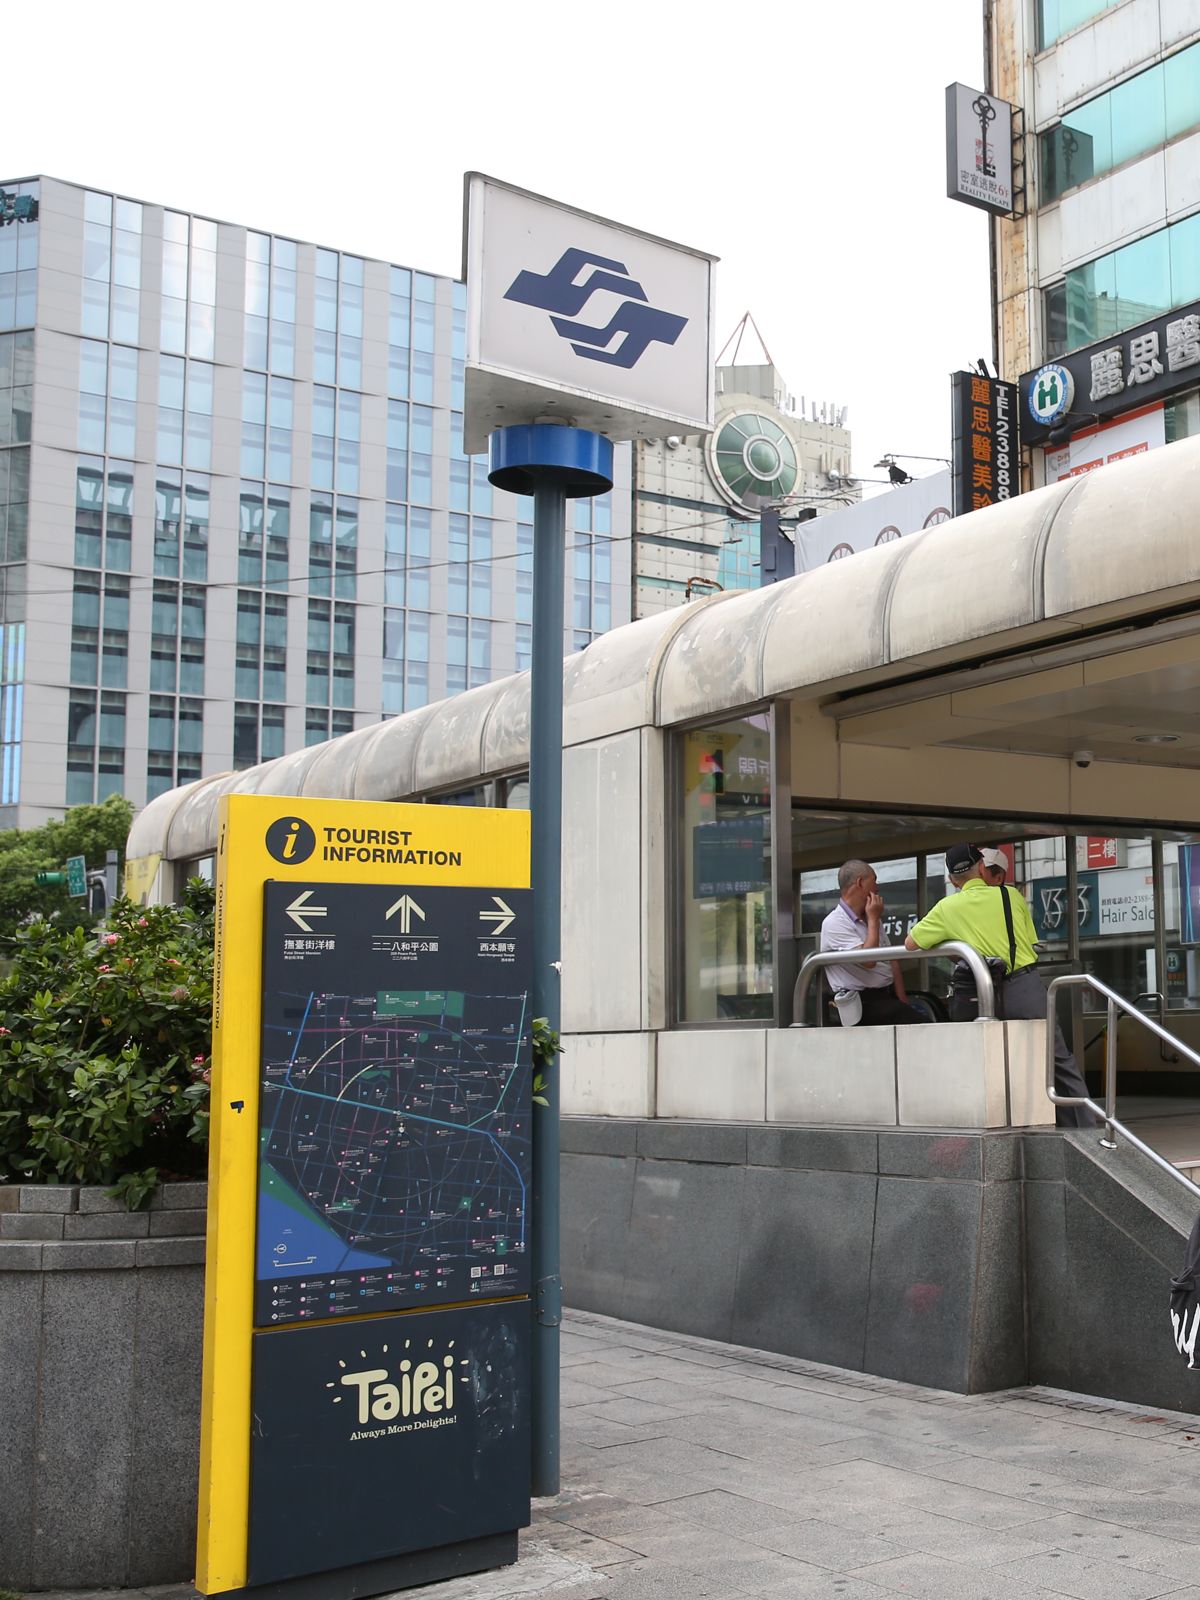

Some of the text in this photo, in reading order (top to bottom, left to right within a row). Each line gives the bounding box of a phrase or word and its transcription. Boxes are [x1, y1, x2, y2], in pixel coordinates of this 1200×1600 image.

[323, 827, 412, 846] TOURIST
[323, 848, 462, 866] INFORMATION
[1101, 908, 1128, 924] Hair
[371, 941, 439, 951] 二二八和平公園
[215, 944, 223, 1029] INFORMATION
[350, 1415, 457, 1441] Always More Delights!
